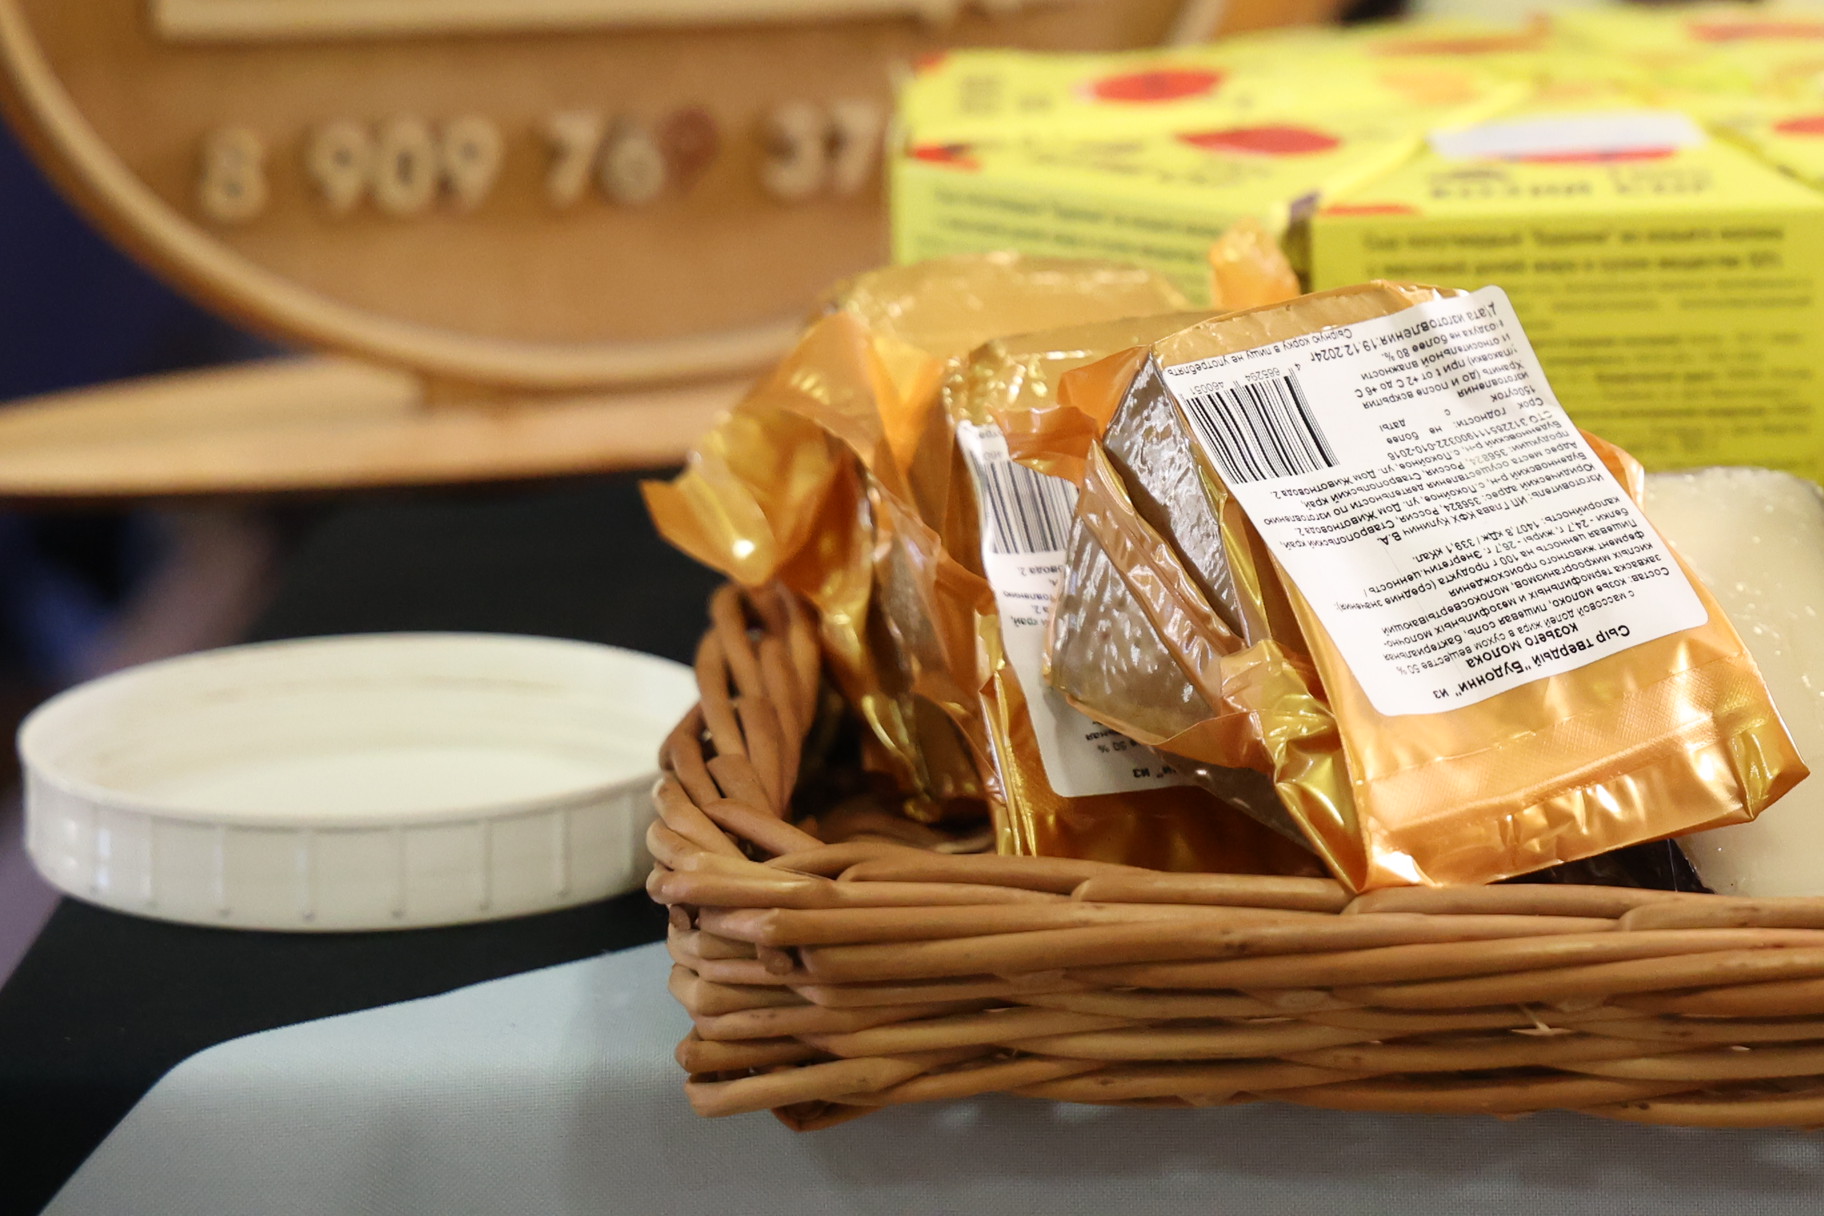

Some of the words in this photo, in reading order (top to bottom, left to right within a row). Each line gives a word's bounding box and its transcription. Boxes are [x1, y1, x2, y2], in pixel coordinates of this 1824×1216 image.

[1278, 333, 1311, 351] корку
[1307, 325, 1353, 344] Сырную
[1310, 314, 1463, 363] изготовления:19.12.2024г
[1411, 334, 1449, 353] более
[1241, 343, 1273, 360] пищу
[1419, 337, 1501, 369] относительной
[1167, 354, 1230, 377] употреблять
[1244, 367, 1281, 383] 665294
[1360, 359, 1420, 381] влажности
[1442, 359, 1466, 374] при
[1456, 371, 1529, 399] изготовления
[1461, 368, 1482, 383] (до
[1189, 381, 1225, 396] 460051
[1415, 380, 1450, 397] после
[1489, 384, 1537, 403] 150суток
[1361, 390, 1415, 410] вскрытия
[1516, 396, 1545, 410] Срок
[1379, 418, 1407, 433] даты
[1453, 406, 1507, 429] годности:
[1385, 431, 1420, 445] более
[1483, 420, 1563, 449] Буденновский
[1507, 430, 1571, 453] продукции:
[1464, 448, 1509, 466] 356824,
[1509, 450, 1544, 465] места
[1544, 441, 1578, 455] Адрес
[1377, 463, 1396, 475] ул.
[1394, 449, 1461, 470] с.Покойное,
[1421, 461, 1466, 477] Россия,
[1509, 451, 1588, 481] Буденновский
[1352, 468, 1377, 482] Дом
[1425, 460, 1510, 489] осуществления
[1519, 462, 1596, 491] Юридический
[1280, 476, 1354, 497] Животновода
[1329, 472, 1423, 505] Ставропольский
[1419, 481, 1486, 503] с.Покойное,
[1480, 483, 1519, 500] адрес:
[1527, 472, 1605, 500] Изготовитель:
[1301, 495, 1330, 509] край,
[1349, 482, 1425, 510] деятельности
[1402, 496, 1421, 508] ул.
[1439, 496, 1482, 513] 356824,
[1377, 501, 1403, 516] Дом
[1394, 507, 1441, 524] Россия,
[1449, 510, 1477, 524] КФХ
[1475, 501, 1511, 516] Глава
[1540, 496, 1621, 525] калорийность:
[1595, 507, 1630, 522] белки
[1263, 511, 1332, 526] изготовлению
[1303, 510, 1379, 535] Животновода
[1401, 516, 1451, 536] Кулинич
[1567, 518, 1590, 533] 24,7
[1308, 519, 1396, 547] Ставропольский
[1480, 530, 1504, 542] кДж
[1504, 520, 1540, 537] 1407,8
[1522, 529, 1556, 544] жиры
[1587, 518, 1638, 539] Пищевая
[1278, 538, 1307, 550] край,
[1376, 531, 1403, 546] В.А.
[1445, 538, 1476, 555] 339,1
[1494, 540, 1517, 554] 26,7
[1535, 533, 1587, 552] ценность
[1597, 529, 1645, 551] фермент
[1412, 547, 1444, 563] кКал.
[1498, 553, 1519, 566] 100
[1538, 544, 1597, 567] животного
[1611, 541, 1654, 560] кислых
[1368, 549, 1483, 594] Энергетич.ценность
[1510, 554, 1612, 589] микроорганизмов,
[1612, 553, 1662, 573] закваска
[1436, 561, 1491, 586] продукта
[1447, 561, 1538, 598] происхождения
[1626, 565, 1670, 583] Состав:
[1383, 579, 1437, 605] (средние
[1527, 567, 1614, 600] термофильных
[1595, 577, 1627, 593] козье
[1547, 587, 1595, 608] молоко,
[1576, 592, 1627, 617] массовой
[1382, 584, 1511, 637] молокосвертывающий
[1433, 597, 1518, 635] мезофильных
[1497, 603, 1548, 626] пищевая
[1543, 608, 1575, 628] долей
[1463, 620, 1497, 636] соль,
[1516, 620, 1543, 635] жира
[1524, 621, 1579, 647] козьего
[1595, 624, 1631, 644] Сыр
[1383, 629, 1434, 648] молочно-
[1383, 633, 1463, 661] бактериальная
[1473, 632, 1507, 651] сухом
[1420, 645, 1473, 670] веществе
[1465, 640, 1523, 669] молока
[1531, 638, 1595, 667] твердый
[1455, 660, 1532, 697] "Будонни"
